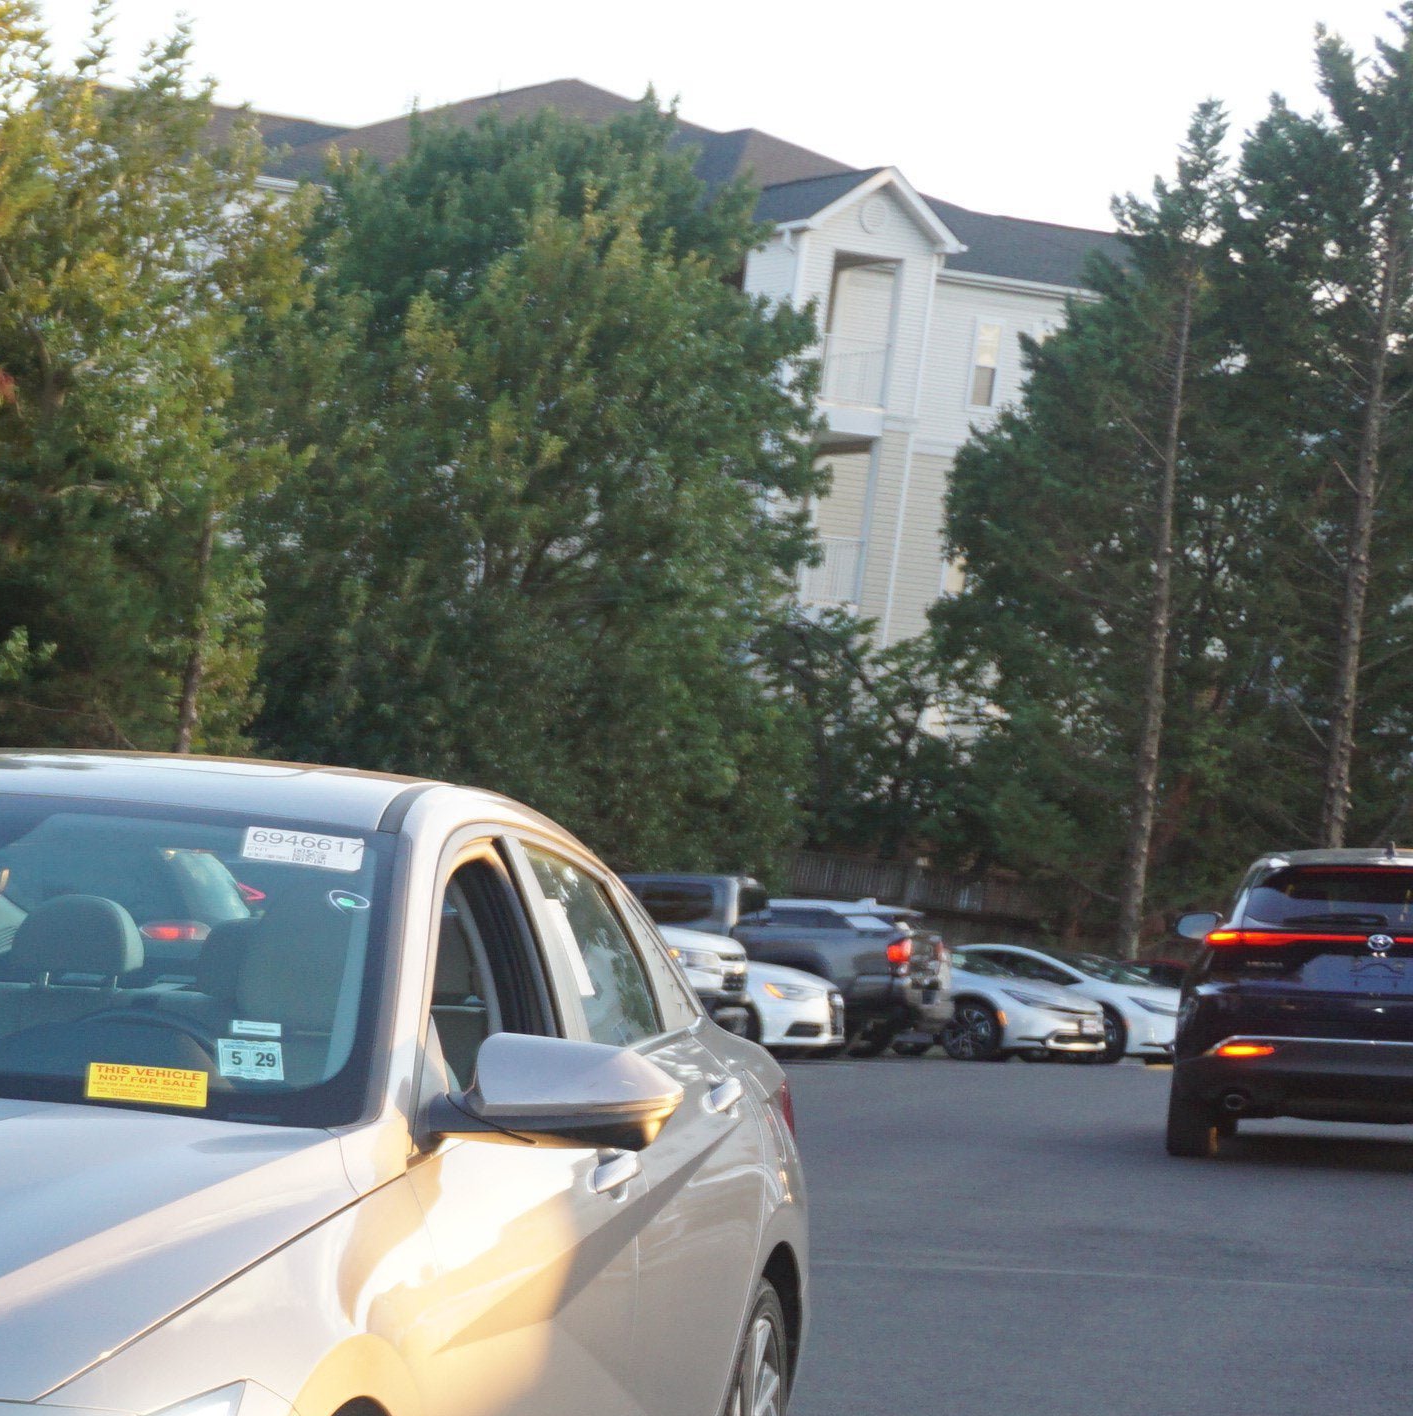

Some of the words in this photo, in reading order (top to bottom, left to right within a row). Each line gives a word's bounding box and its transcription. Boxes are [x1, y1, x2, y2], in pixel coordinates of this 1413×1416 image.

[253, 831, 364, 854] 6946617
[232, 1051, 243, 1066] 5
[255, 1052, 277, 1068] 29
[96, 1064, 130, 1075] THIS
[136, 1067, 202, 1081] VEHICLE
[99, 1074, 126, 1082] NOT
[130, 1076, 158, 1085] FOR
[162, 1079, 198, 1089] SALE
